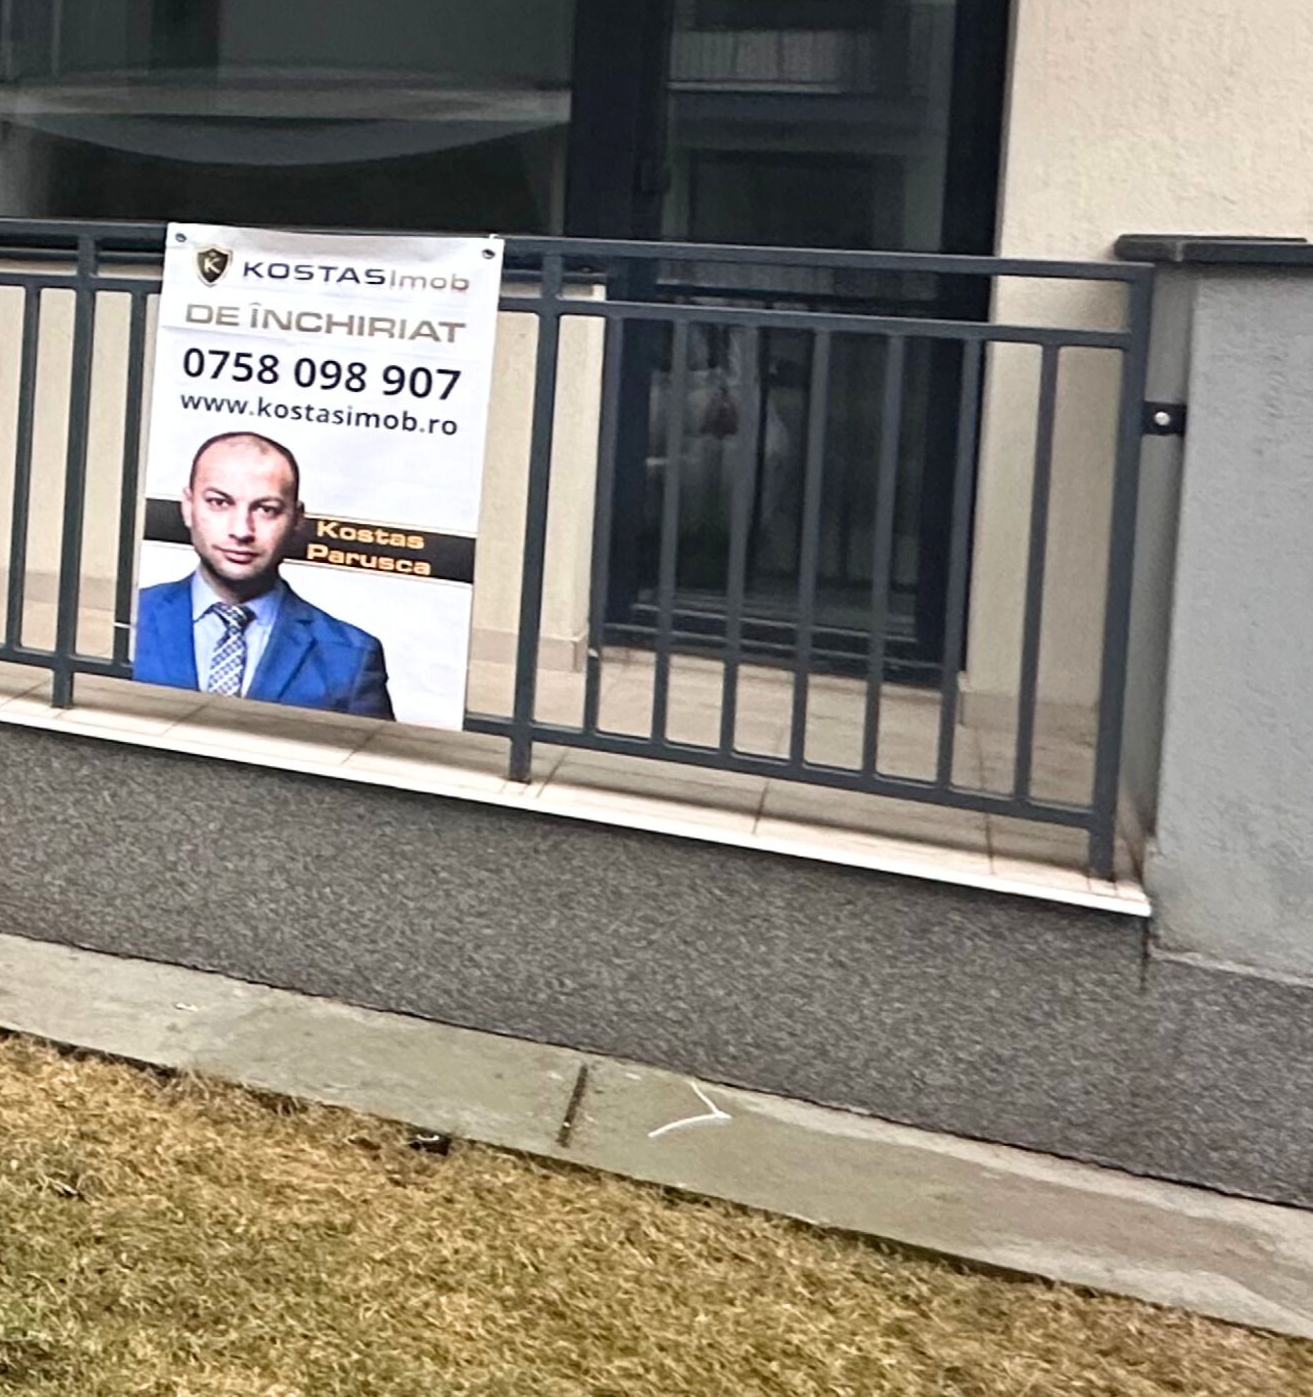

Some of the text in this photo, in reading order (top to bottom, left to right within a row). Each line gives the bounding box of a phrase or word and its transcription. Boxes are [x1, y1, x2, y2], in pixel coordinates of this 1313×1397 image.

[185, 302, 466, 343] DE ÎNCHIRIAT
[183, 348, 462, 400] 0758 098 907
[181, 394, 458, 435] www.kostasimob.ro
[316, 521, 425, 550] Kostas
[307, 544, 432, 576] Parusca
